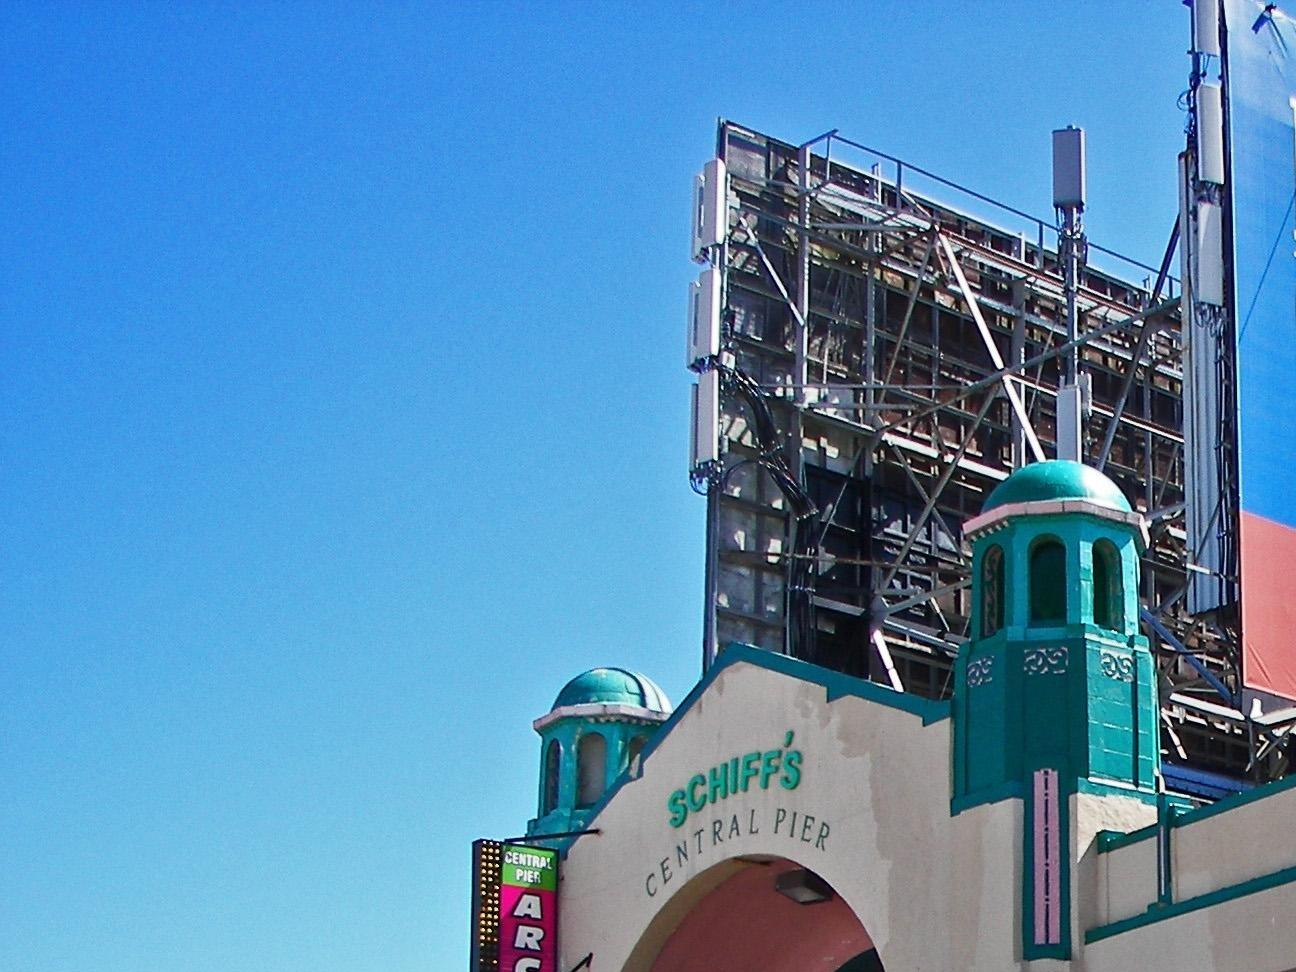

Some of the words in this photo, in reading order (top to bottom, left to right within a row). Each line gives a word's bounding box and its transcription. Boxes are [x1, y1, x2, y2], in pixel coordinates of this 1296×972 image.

[667, 730, 803, 828] SCHIFF'S
[504, 851, 552, 870] CENTRAL
[515, 869, 541, 883] PIER
[645, 808, 760, 898] CENTRAL
[774, 808, 831, 851] PIER
